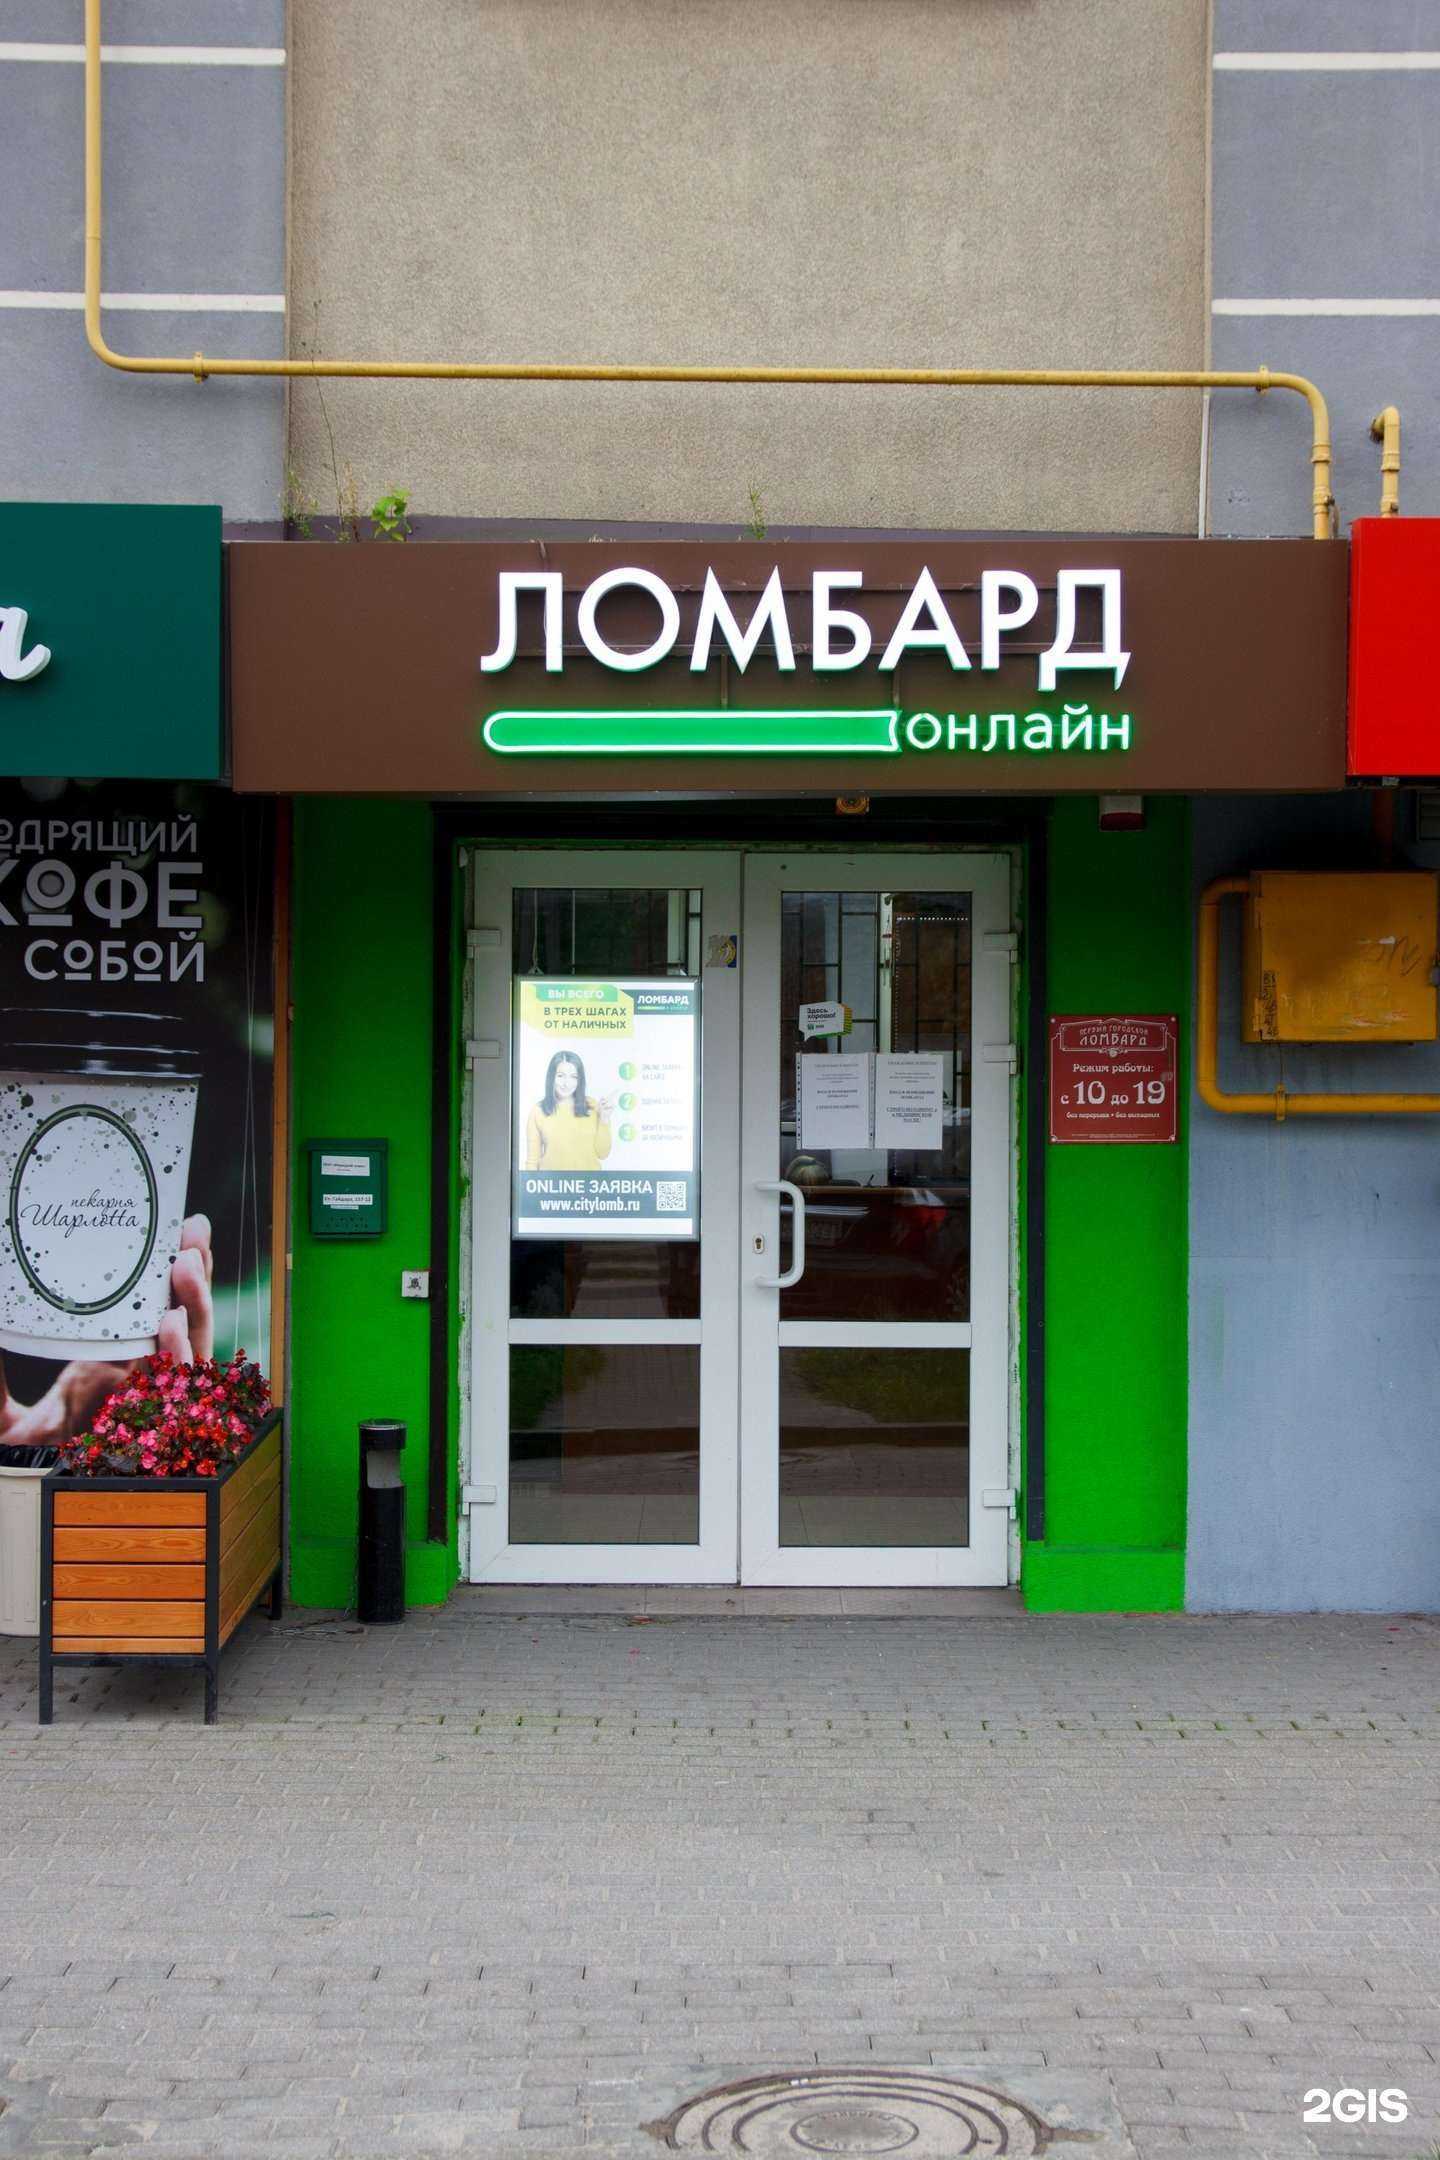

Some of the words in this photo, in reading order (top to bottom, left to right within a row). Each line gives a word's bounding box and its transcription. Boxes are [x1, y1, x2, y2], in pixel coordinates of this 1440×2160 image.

[480, 564, 1132, 692] ЛОМБАРД
[906, 703, 1130, 752] онлайн
[24, 931, 205, 983] СОБОЙ
[637, 995, 690, 1006] ЛОМБАРД
[544, 1007, 551, 1016] В
[554, 1007, 582, 1016] ТРЕХ
[586, 1007, 627, 1017] ШАГАХ
[544, 1020, 559, 1030] ОТ
[562, 1020, 627, 1030] НАЛИЧНЫХ
[1079, 1033, 1148, 1046] ЛОМБАРД
[1073, 1063, 1109, 1073] Режим
[1112, 1062, 1154, 1075] работы:
[1060, 1094, 1070, 1105] с
[1073, 1080, 1106, 1105] 10
[1110, 1094, 1129, 1106] до
[1132, 1080, 1166, 1105] 19
[526, 1179, 585, 1194] ONLINE
[589, 1179, 653, 1194] ЗАЯВКА
[70, 1188, 138, 1216] пекарня
[540, 1197, 640, 1214] www.citylomb.ru
